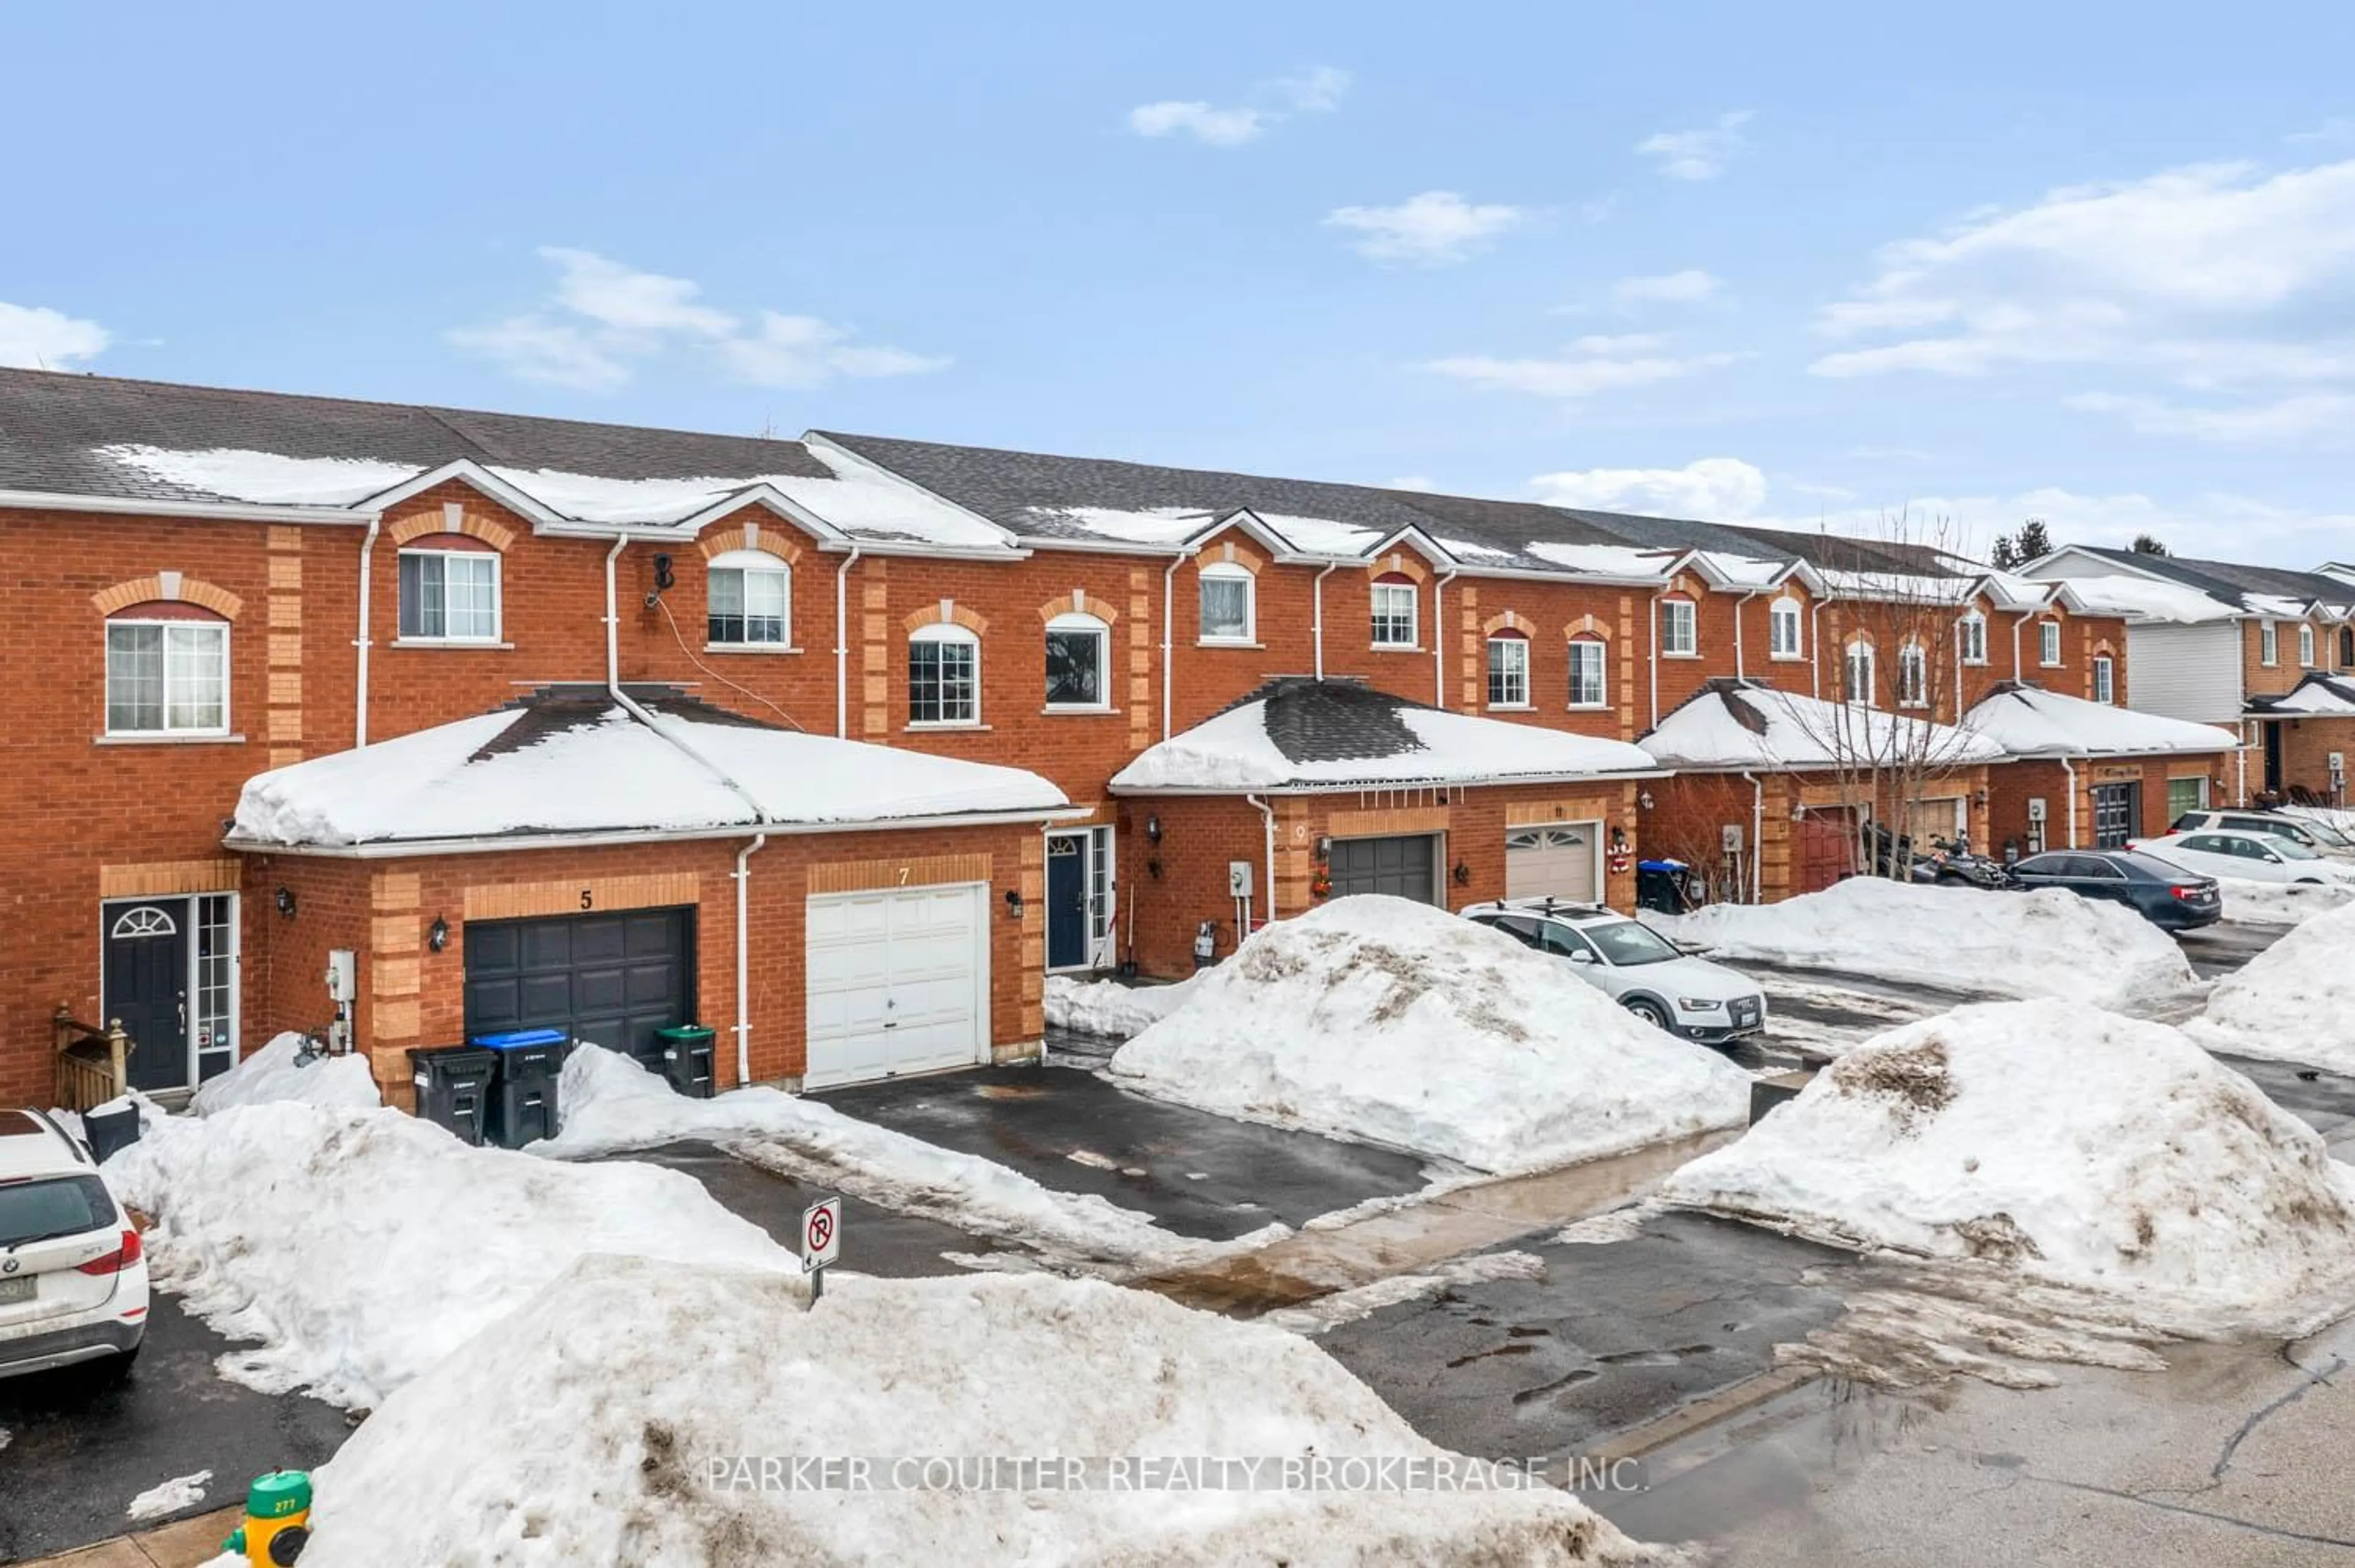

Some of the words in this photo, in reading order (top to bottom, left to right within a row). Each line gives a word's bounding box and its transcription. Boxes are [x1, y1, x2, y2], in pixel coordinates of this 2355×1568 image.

[1295, 825, 1306, 843] 9
[899, 867, 910, 885] 7
[580, 890, 592, 910] 5
[275, 1498, 296, 1513] 277
